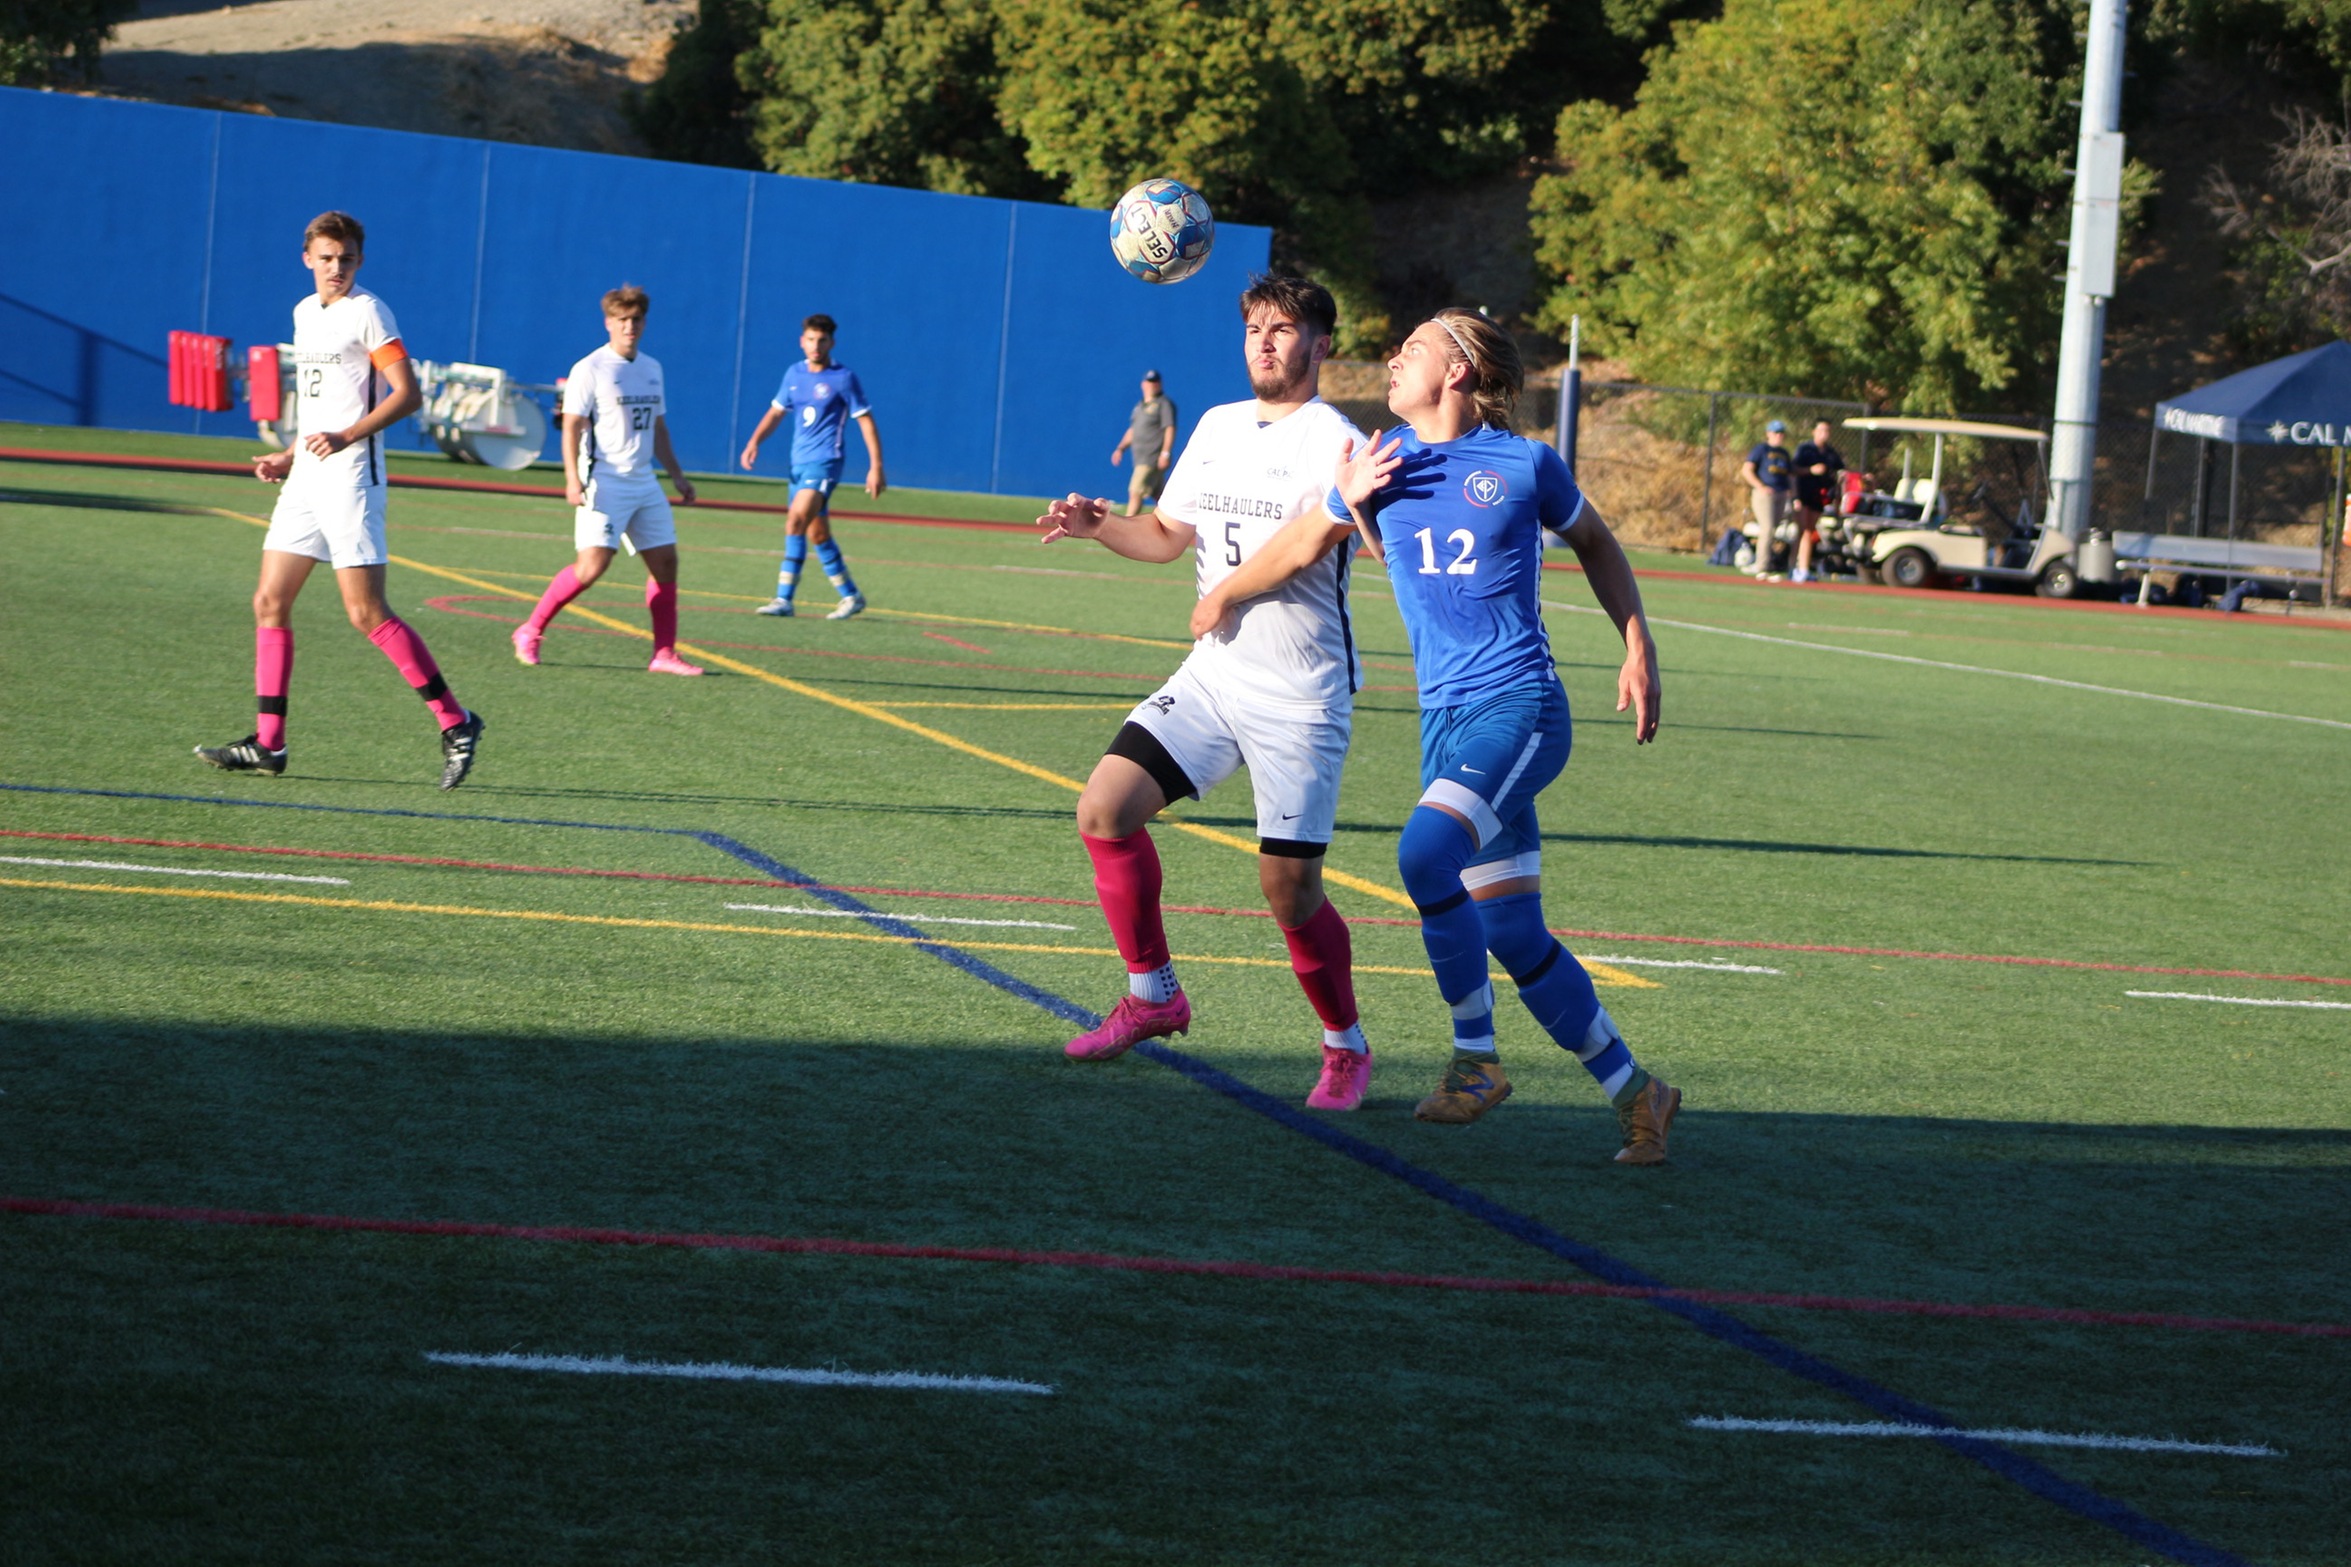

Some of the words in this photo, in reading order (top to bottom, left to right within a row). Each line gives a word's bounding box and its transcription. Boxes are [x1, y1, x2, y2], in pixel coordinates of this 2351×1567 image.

[1131, 206, 1168, 259] SELECT
[304, 368, 323, 398] 12
[632, 406, 652, 430] 27
[802, 405, 817, 428] 9
[2290, 420, 2338, 447] CAL
[1225, 521, 1242, 567] 5
[1414, 527, 1477, 575] 12
